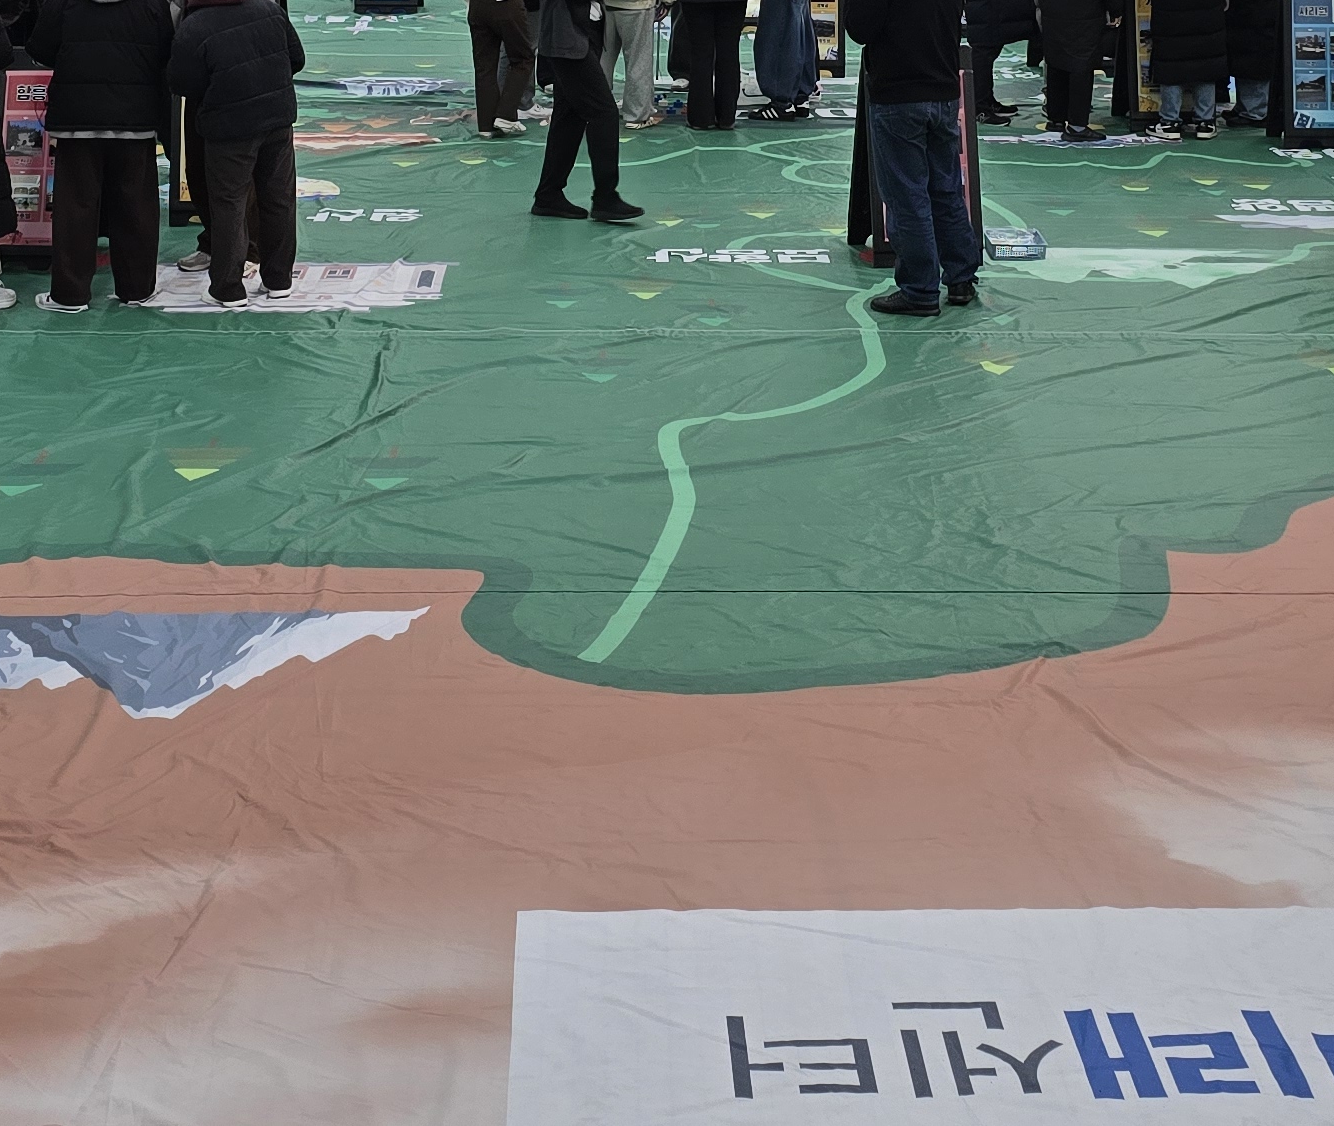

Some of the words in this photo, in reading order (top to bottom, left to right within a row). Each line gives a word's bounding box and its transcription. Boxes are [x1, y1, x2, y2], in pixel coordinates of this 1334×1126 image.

[1298, 6, 1328, 17] 사리원
[16, 84, 48, 102] 함흥
[306, 207, 424, 223] 원산
[646, 248, 831, 264] 묘향산
